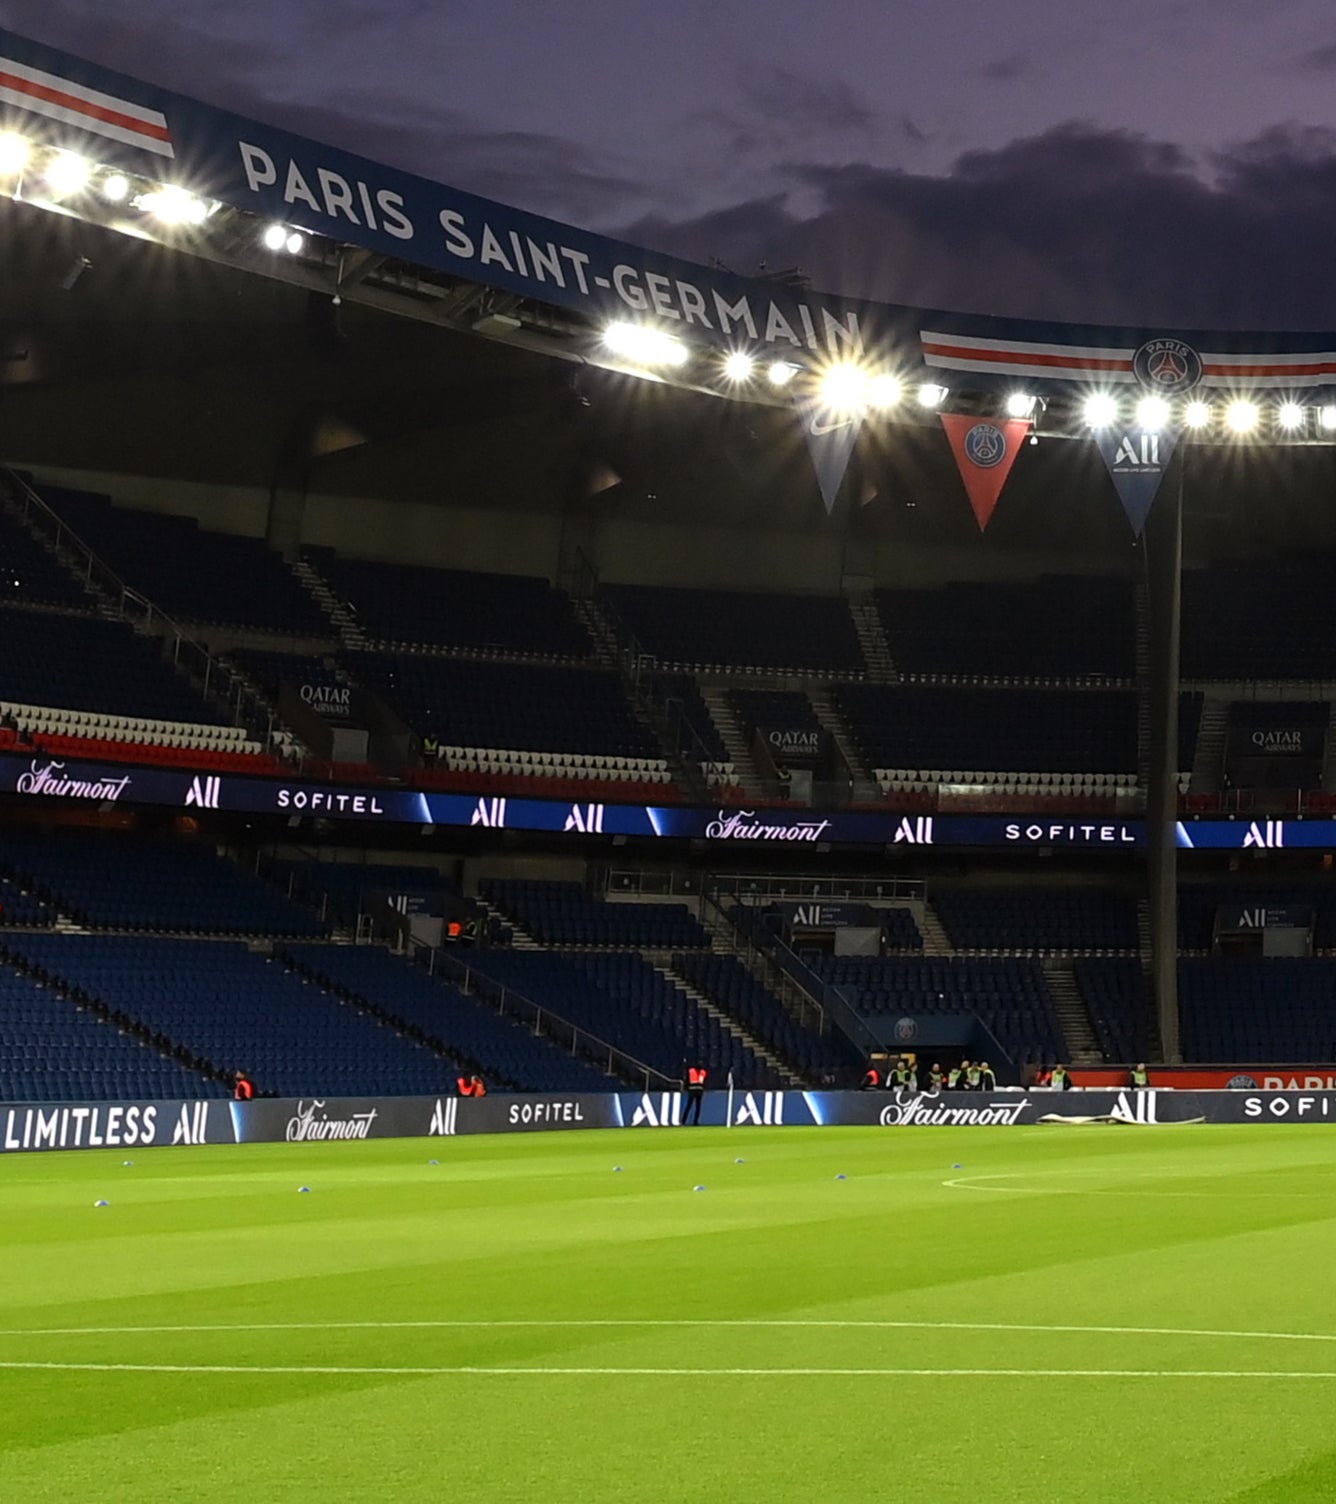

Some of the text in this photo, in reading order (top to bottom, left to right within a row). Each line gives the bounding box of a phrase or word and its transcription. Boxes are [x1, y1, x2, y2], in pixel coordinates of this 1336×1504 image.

[239, 142, 866, 354] PARIS SAINT-GERMAIN
[1146, 341, 1190, 356] PARIS
[300, 685, 350, 704] QATAR
[770, 731, 819, 747] QATAR
[1252, 732, 1302, 746] QATAR
[17, 760, 131, 801] Fairmont
[278, 790, 382, 813] SOFITEL
[706, 810, 832, 842] Fairmont
[1006, 824, 1134, 841] SOFITEL
[509, 1101, 583, 1123] SOFITEL
[881, 1090, 1032, 1125] Fairmont
[5, 1106, 156, 1149] LIMITLESS
[287, 1101, 377, 1141] Fairmont
